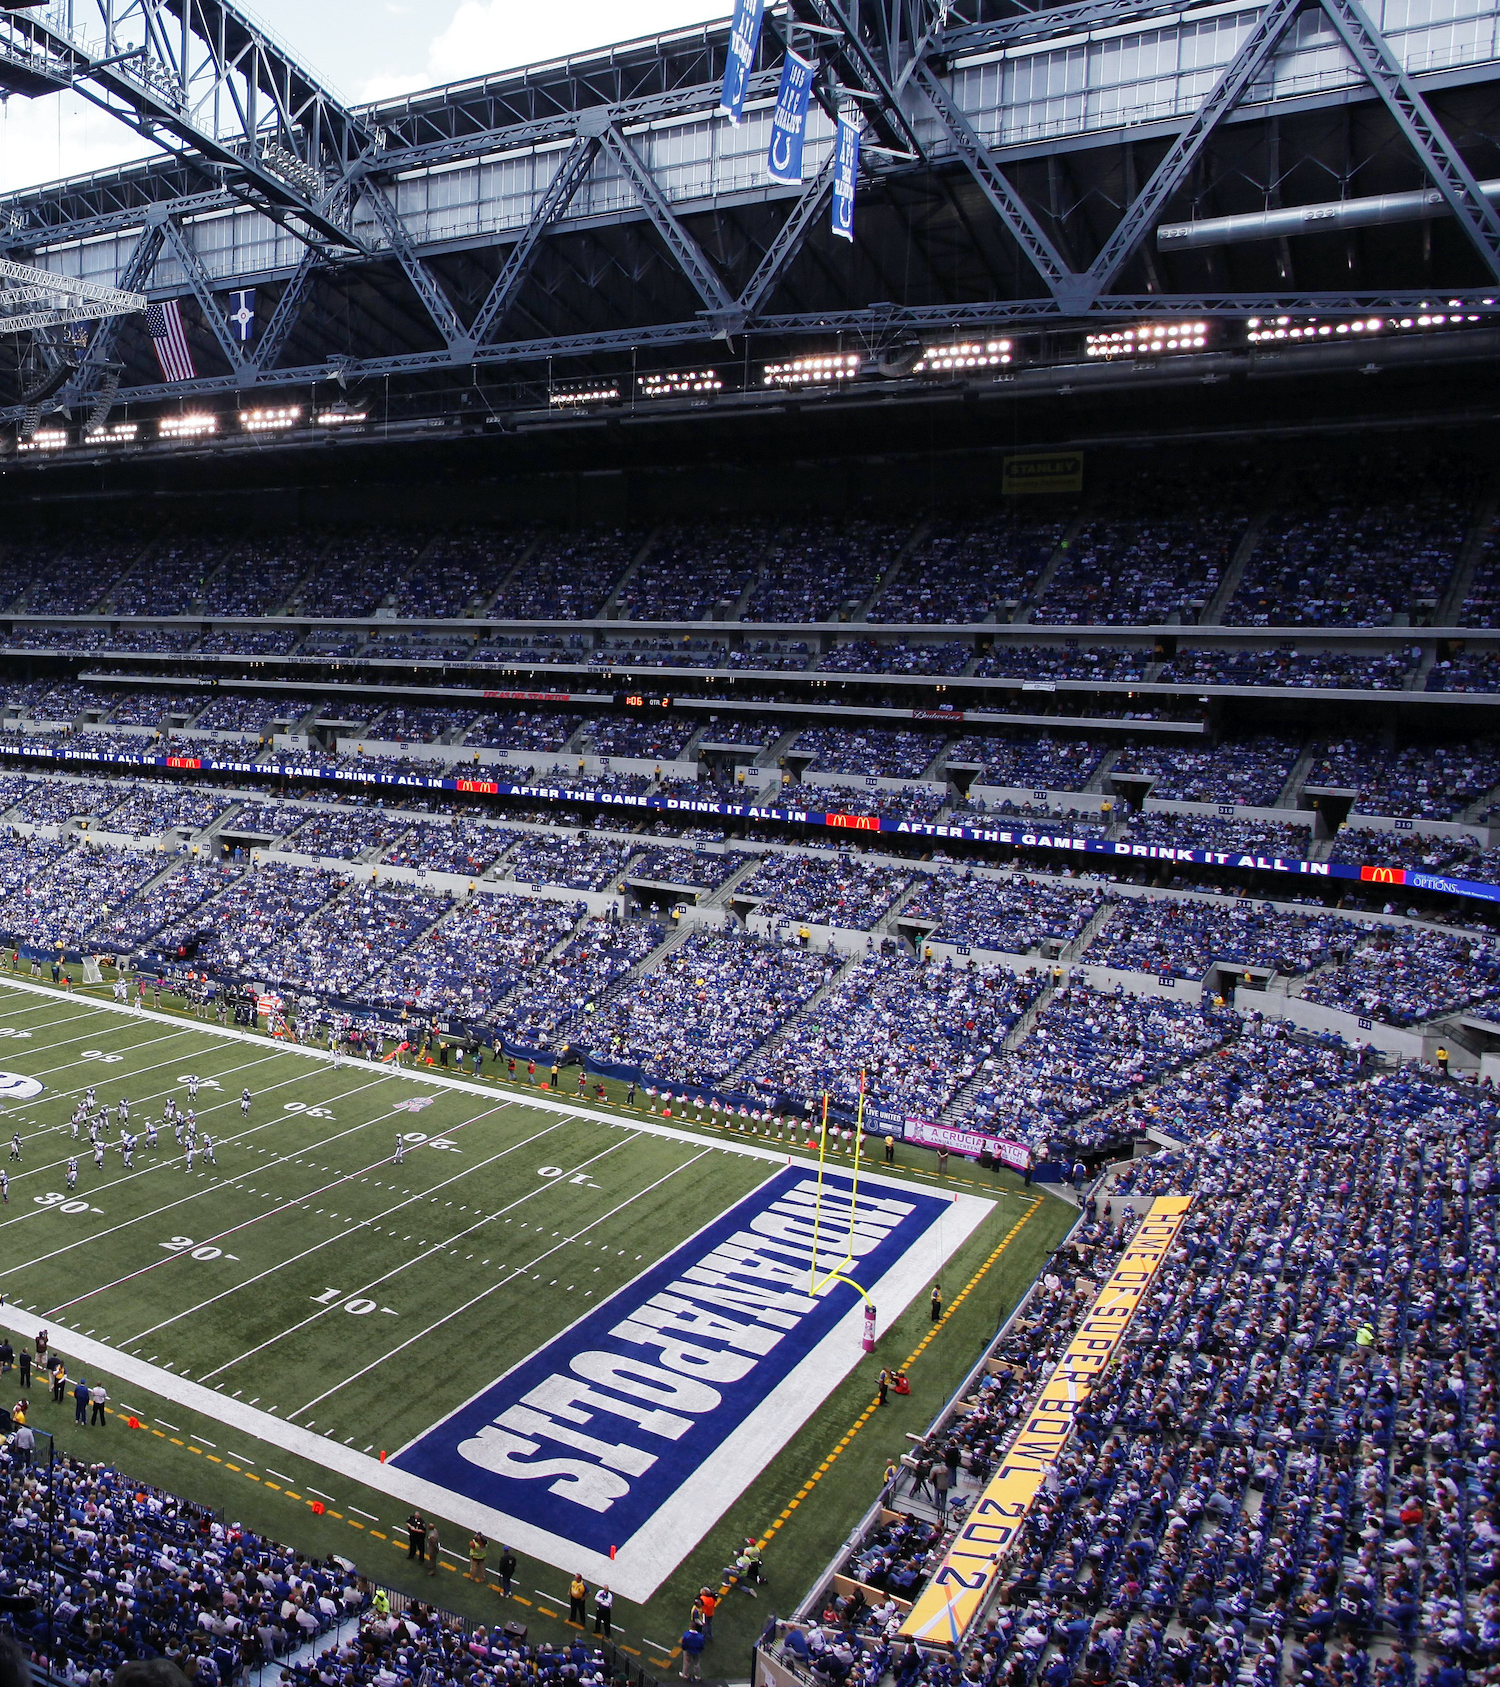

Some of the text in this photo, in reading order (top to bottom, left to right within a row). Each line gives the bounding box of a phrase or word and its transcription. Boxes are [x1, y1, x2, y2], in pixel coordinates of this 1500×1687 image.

[1010, 462, 1075, 475] STANLEY
[484, 691, 510, 699] LUCAS
[528, 693, 570, 702] STADIUM
[626, 696, 642, 706] 1:06
[662, 698, 669, 707] 2
[914, 711, 961, 720] Budweiser
[0, 746, 19, 755] THE
[23, 748, 52, 757] GAME
[65, 751, 100, 760] DRINK
[118, 755, 139, 763] ALL
[143, 756, 156, 764] IN
[211, 761, 442, 788] AFTER THE GAME DRINK IT ALL IN
[510, 785, 806, 822] AFTER THE GAME DRINK IT ALL IN
[1396, 821, 1411, 829] 319
[897, 822, 1331, 875] AFTER THE GAME DRINK IT ALL IN
[1413, 877, 1457, 893] OPTIONS
[957, 947, 969, 955] 117
[1158, 978, 1174, 987] 118
[1358, 1018, 1372, 1029] 121
[81, 1050, 124, 1063] 50
[283, 1102, 332, 1119] 30
[865, 1108, 902, 1122] LIVE UNITED
[931, 1129, 938, 1137] A
[402, 1132, 456, 1150] 20
[931, 1137, 953, 1146] ANNUAL
[537, 1166, 594, 1187] 10
[34, 1192, 88, 1213] 30
[159, 1236, 225, 1262] 20
[310, 1287, 377, 1316] 10
[457, 1179, 917, 1513] INDIANAPOLIS
[935, 1213, 1178, 1589] HOME OF SUPER BOWL 2012
